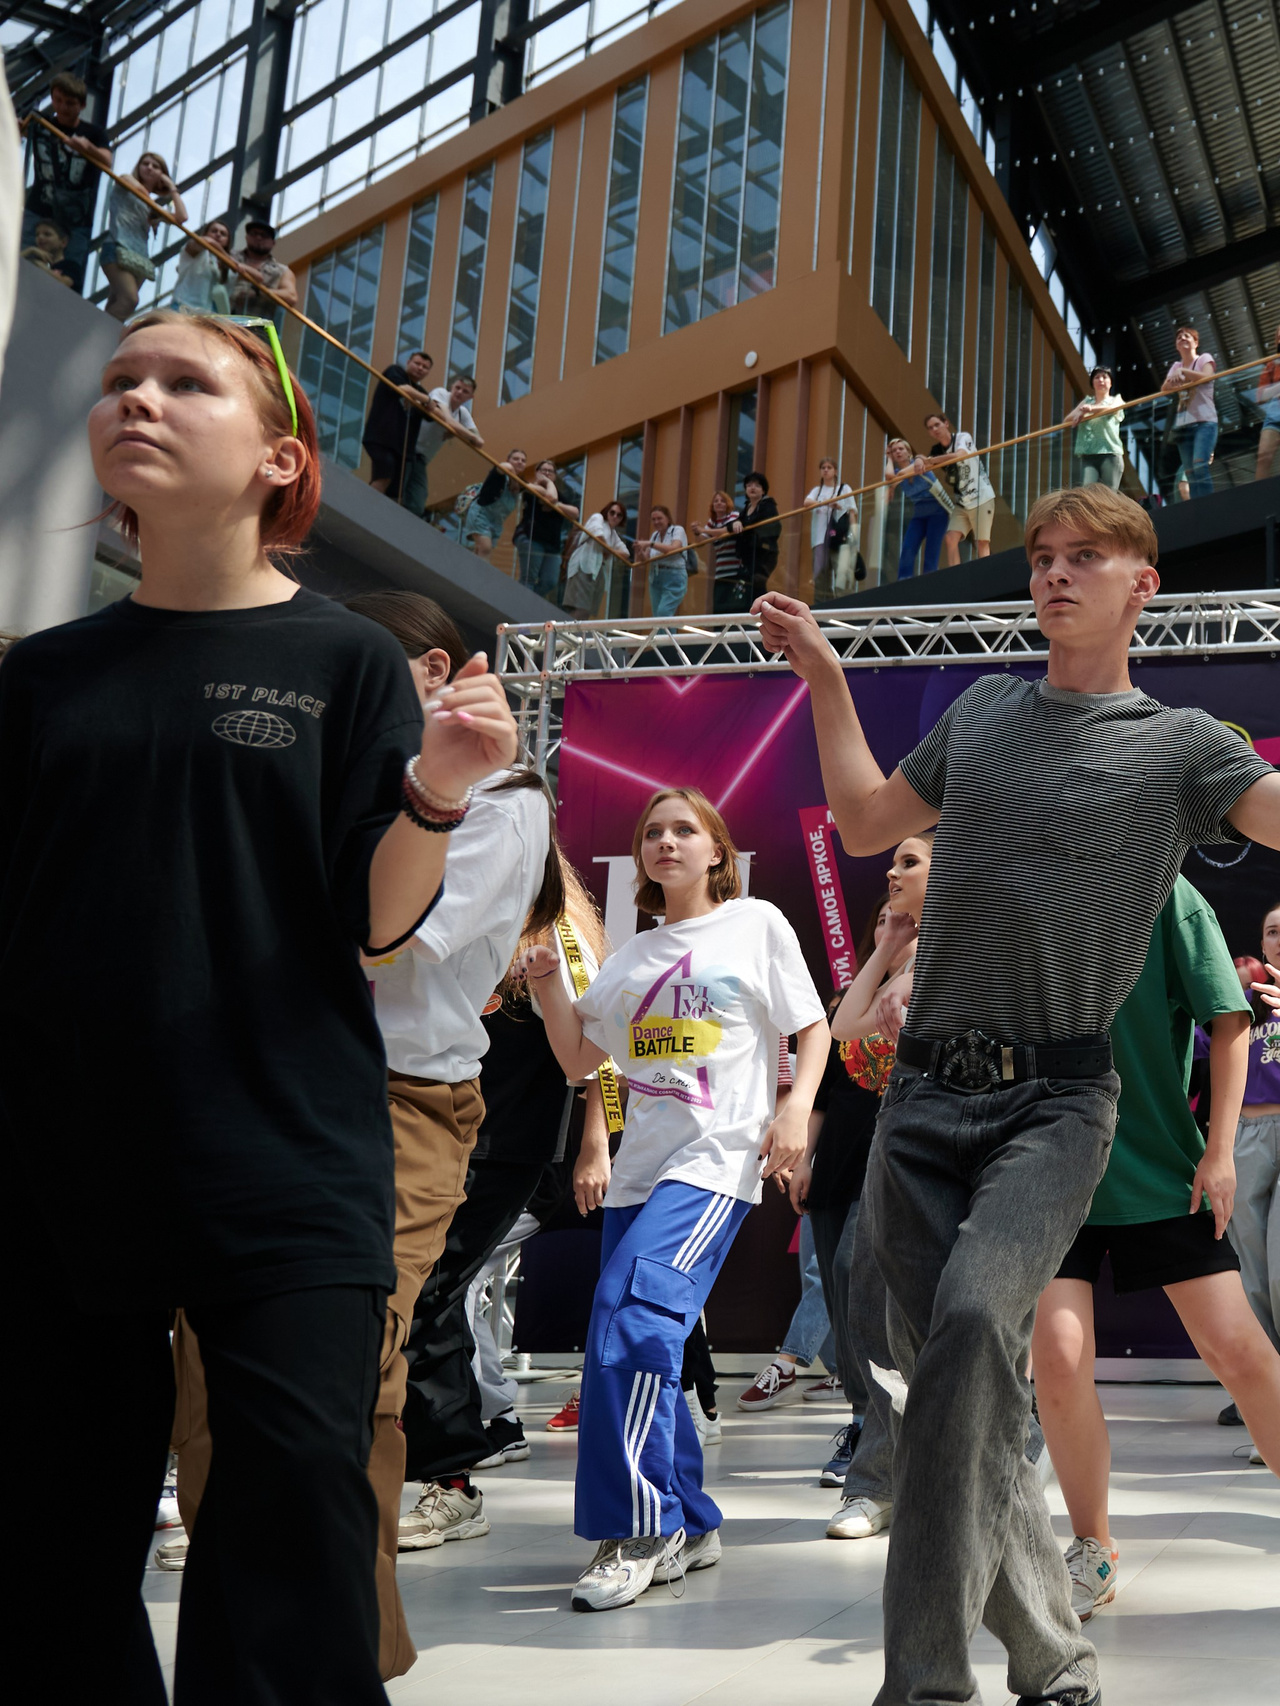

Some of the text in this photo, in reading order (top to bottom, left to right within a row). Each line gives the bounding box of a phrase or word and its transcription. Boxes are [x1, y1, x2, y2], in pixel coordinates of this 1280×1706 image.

[204, 683, 326, 719] 1ST PLACE
[809, 824, 833, 886] ЯРКОЕ,
[821, 886, 845, 949] САМОЕ
[557, 915, 582, 964] WHITE
[632, 1025, 673, 1040] Dance
[634, 1036, 695, 1057] BATTLE
[600, 1068, 620, 1121] WHITE
[652, 1072, 666, 1084] DS
